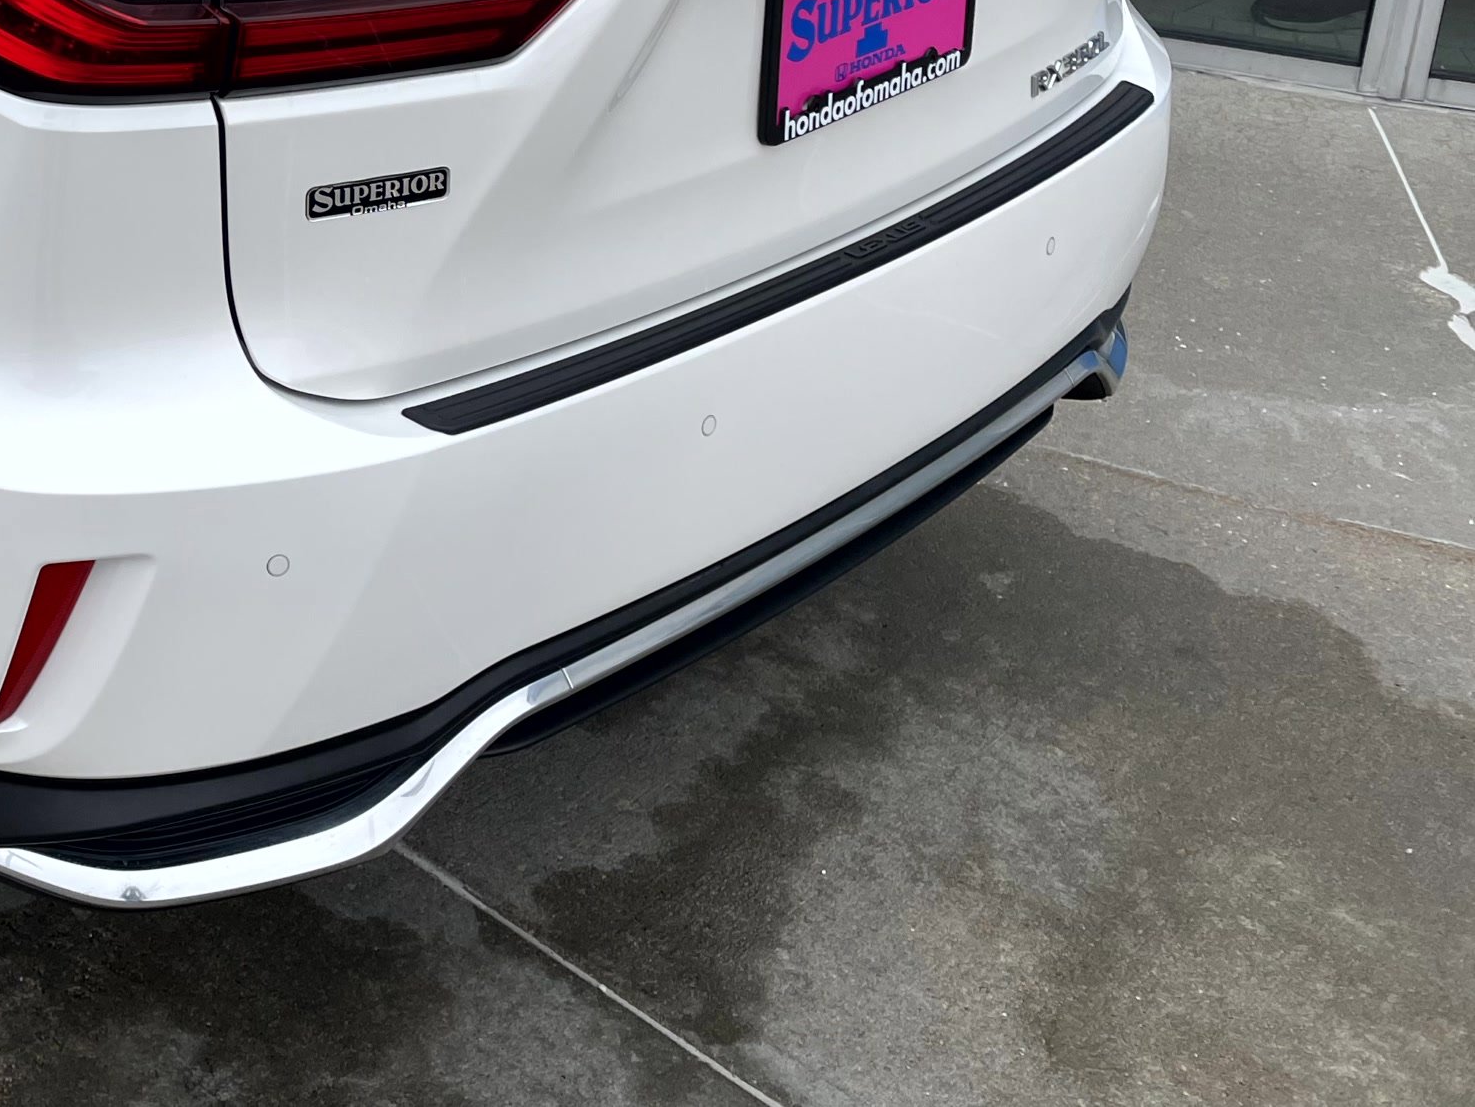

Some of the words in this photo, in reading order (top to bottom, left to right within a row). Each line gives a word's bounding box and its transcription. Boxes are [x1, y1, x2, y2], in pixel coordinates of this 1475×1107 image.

[849, 44, 906, 75] HONDA
[784, 49, 962, 141] hondaofomaha.com
[312, 172, 445, 213] SUPERIOR
[351, 199, 407, 216] Omaha
